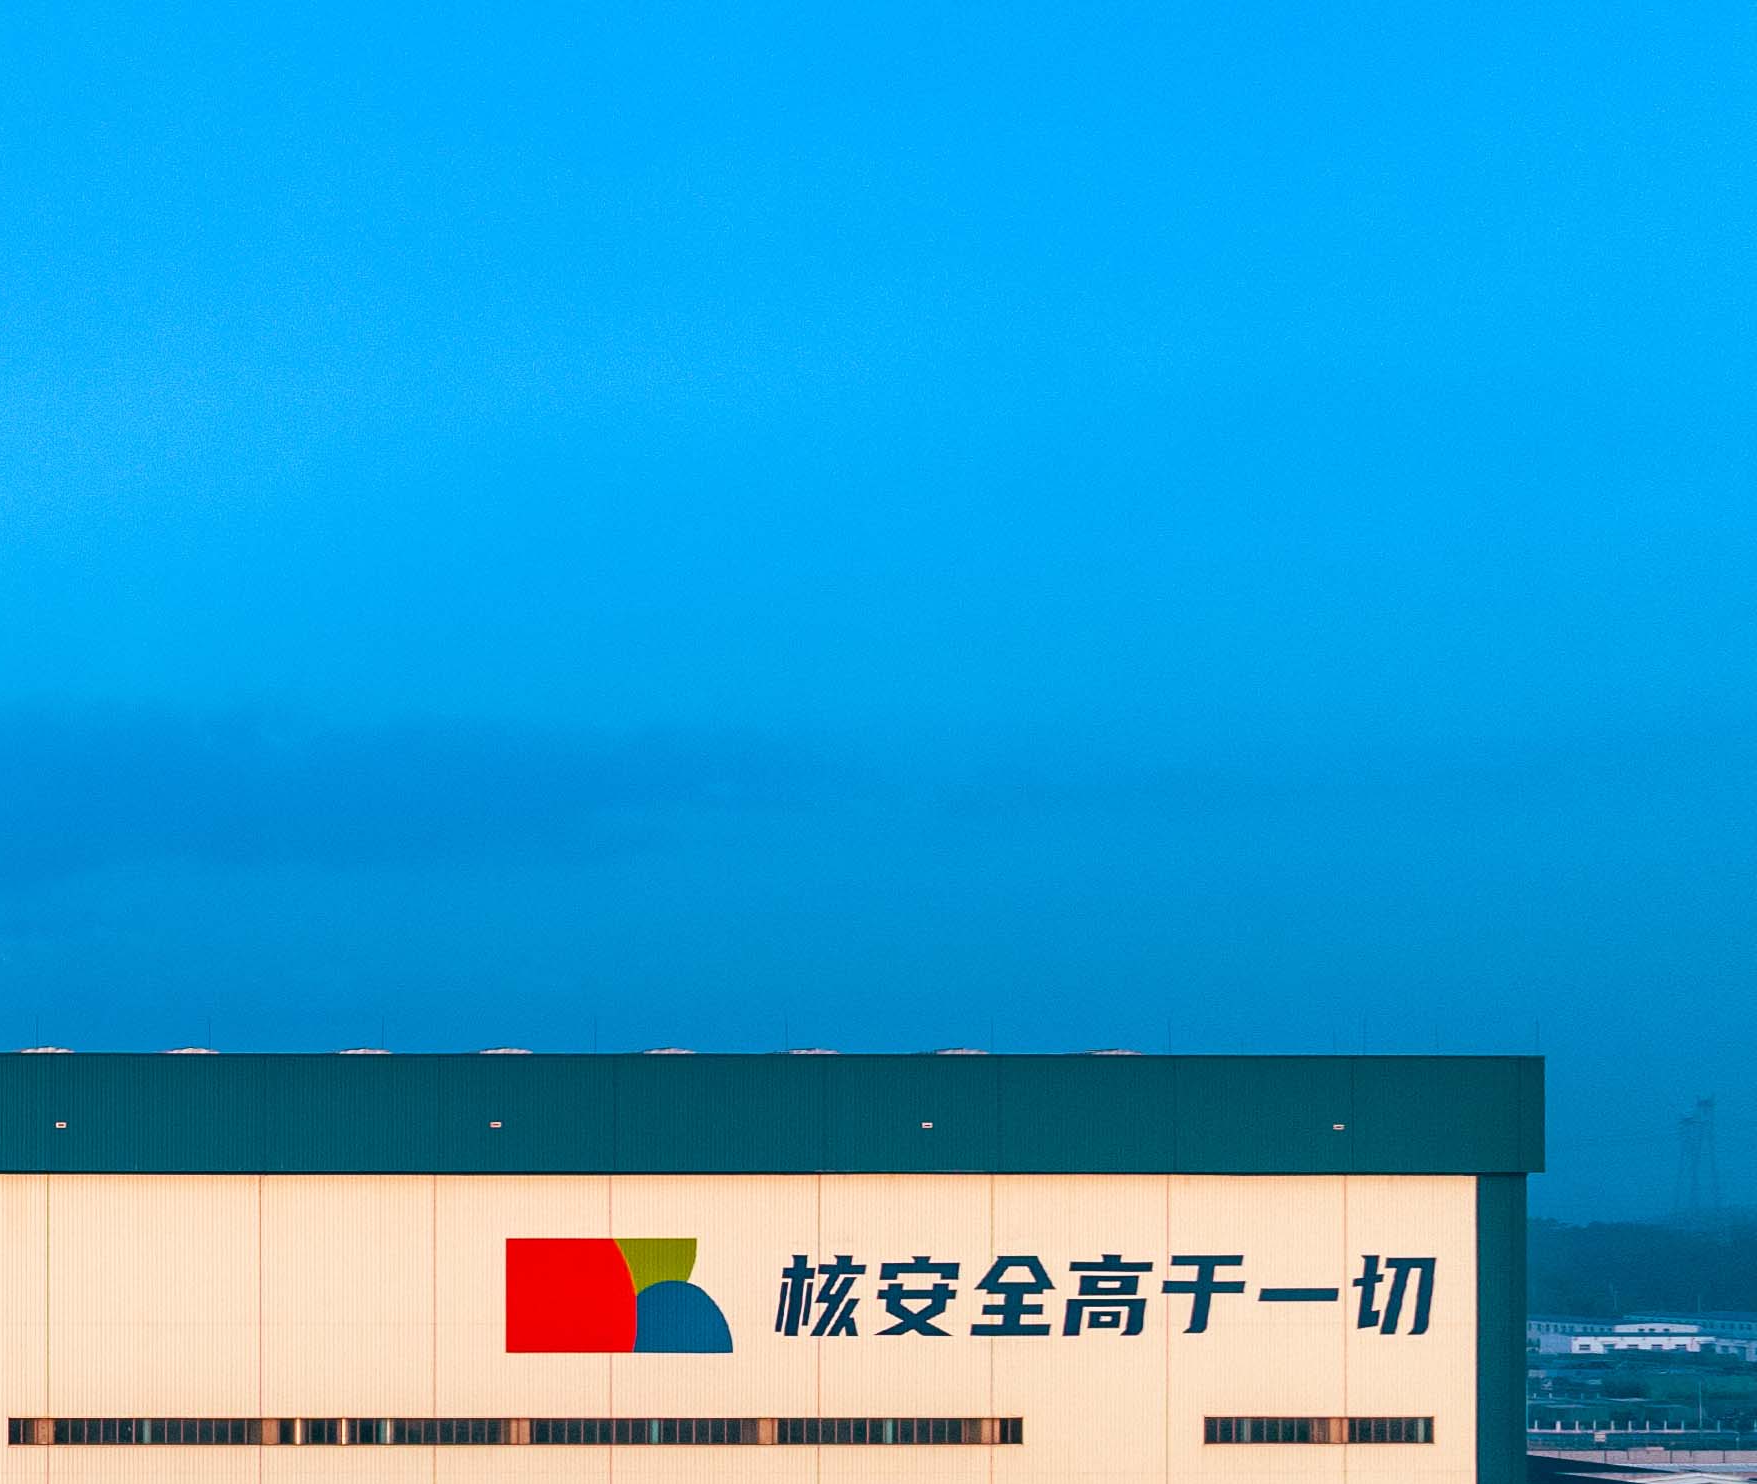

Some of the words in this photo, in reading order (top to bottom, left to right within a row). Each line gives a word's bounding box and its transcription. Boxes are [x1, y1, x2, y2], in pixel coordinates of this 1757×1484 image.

[774, 1254, 1438, 1337] 核安全高于一切
